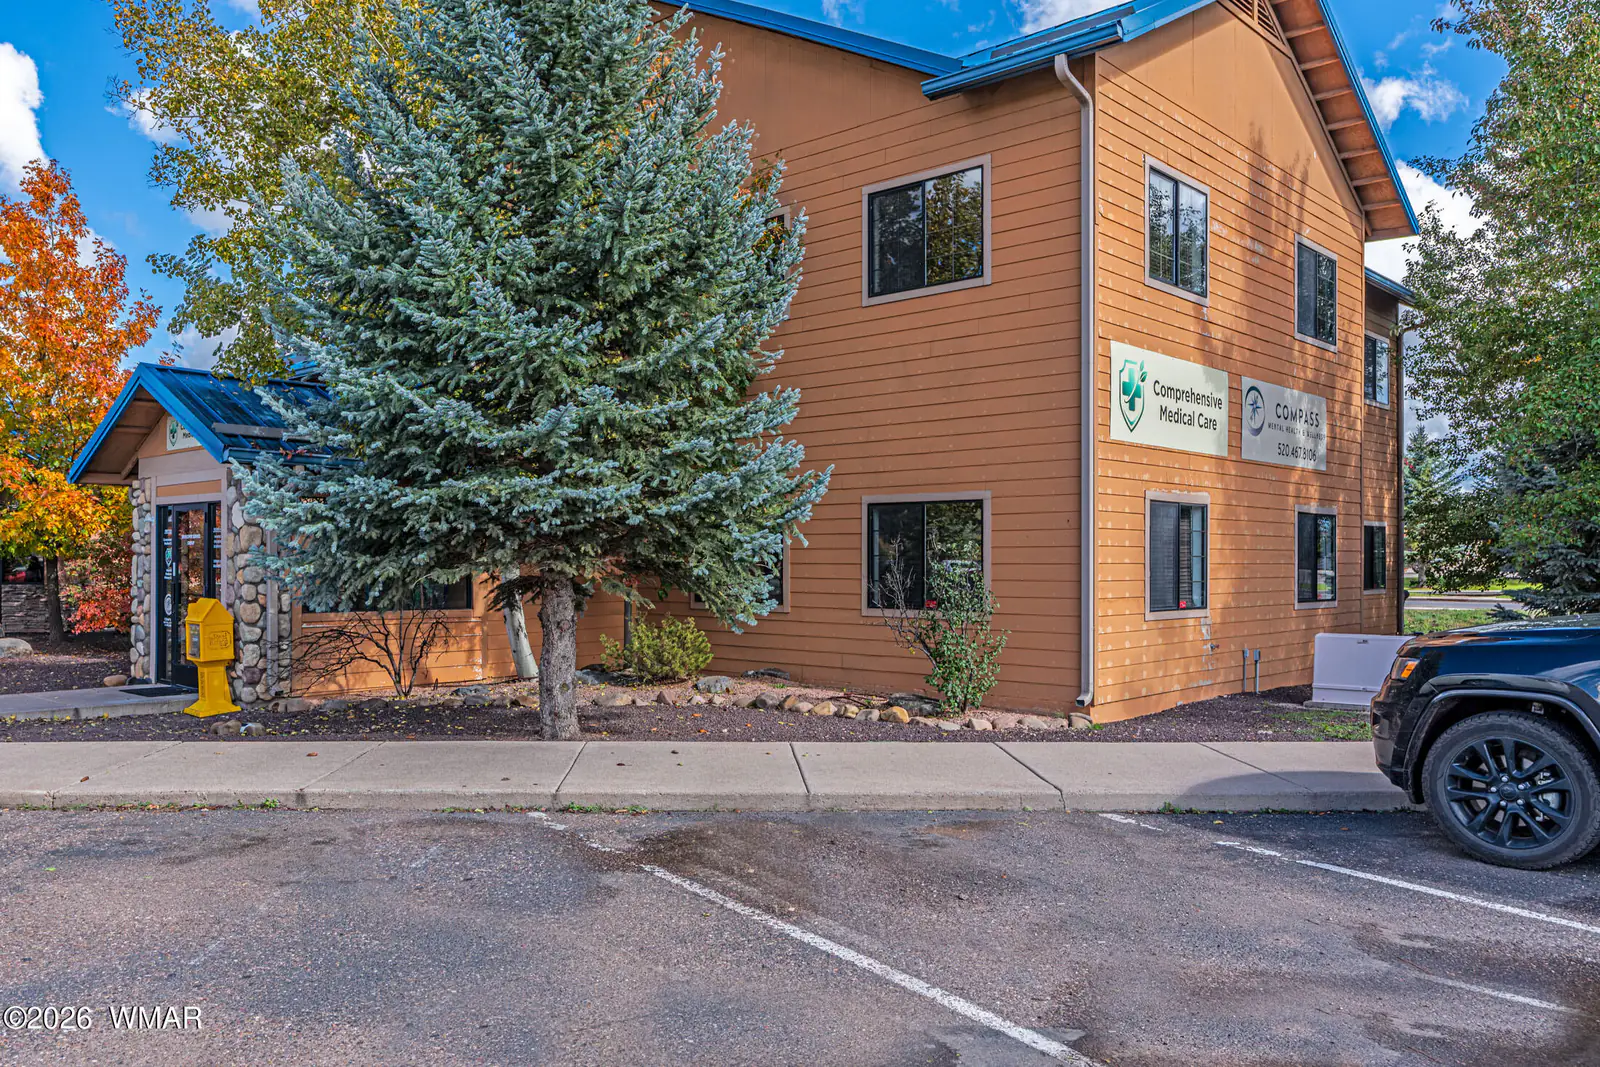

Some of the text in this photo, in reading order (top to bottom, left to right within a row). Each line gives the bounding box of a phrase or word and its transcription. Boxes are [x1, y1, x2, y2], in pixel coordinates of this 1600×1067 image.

[1153, 379, 1223, 410] Comprehensive
[1159, 404, 1218, 431] Medical Care
[1268, 422, 1285, 432] MENTAL
[1275, 403, 1320, 428] COMPASS
[1277, 442, 1317, 462] 520.467.8106
